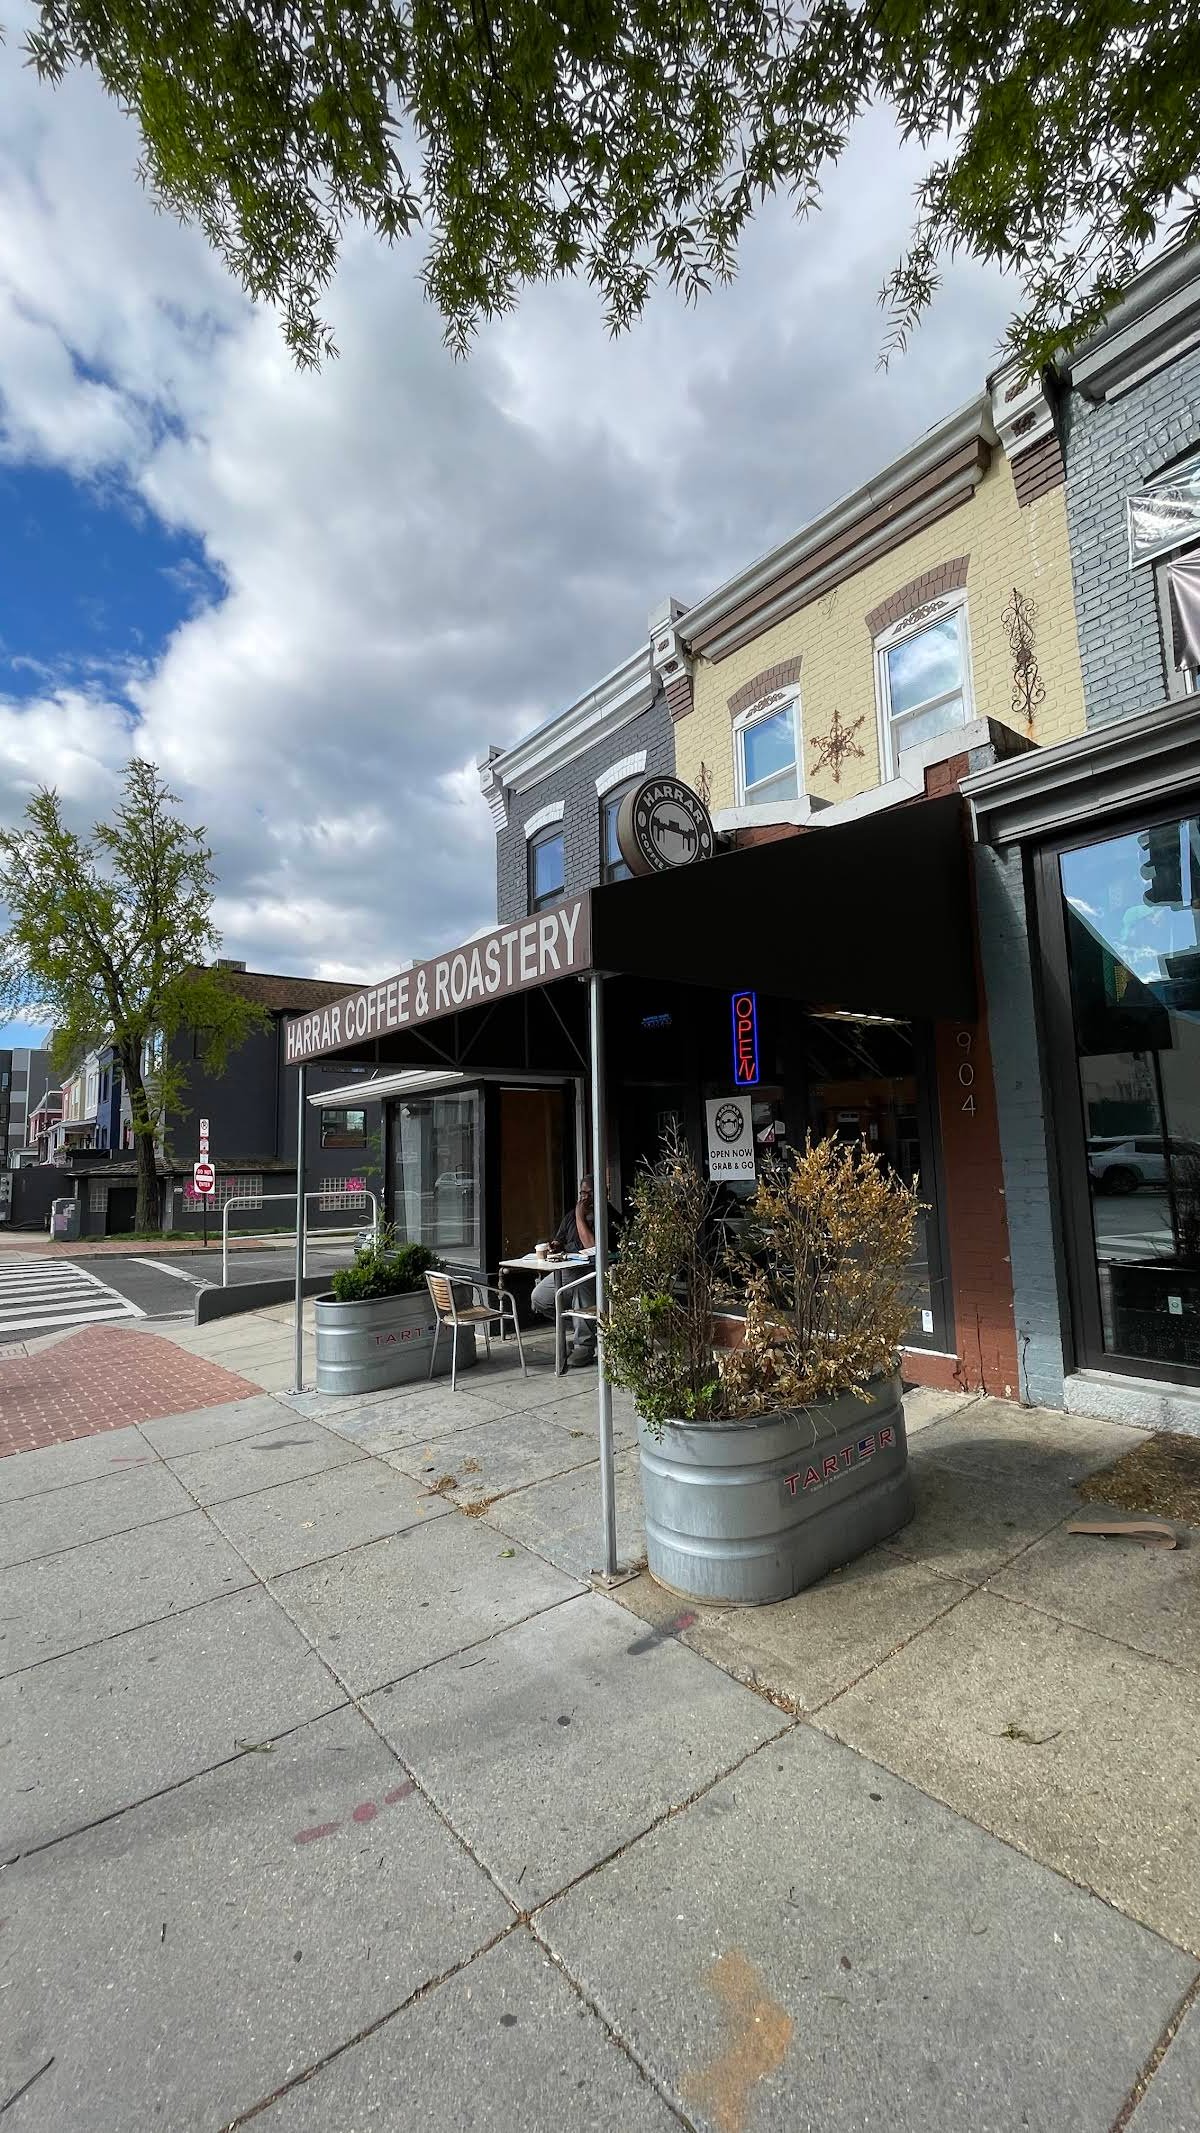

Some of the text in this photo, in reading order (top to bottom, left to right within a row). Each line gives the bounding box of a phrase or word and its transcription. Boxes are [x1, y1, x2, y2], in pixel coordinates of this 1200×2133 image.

[643, 785, 704, 825] HARRAR
[640, 833, 664, 870] COFFEE
[286, 902, 582, 1060] HARRAR COFFEE & ROASTERY
[736, 997, 756, 1081] OPEN
[956, 1031, 977, 1118] 904
[710, 1148, 753, 1159] OPEN NOW
[711, 1162, 733, 1171] GRAB
[741, 1161, 754, 1170] GO
[783, 1426, 895, 1496] TARTER
